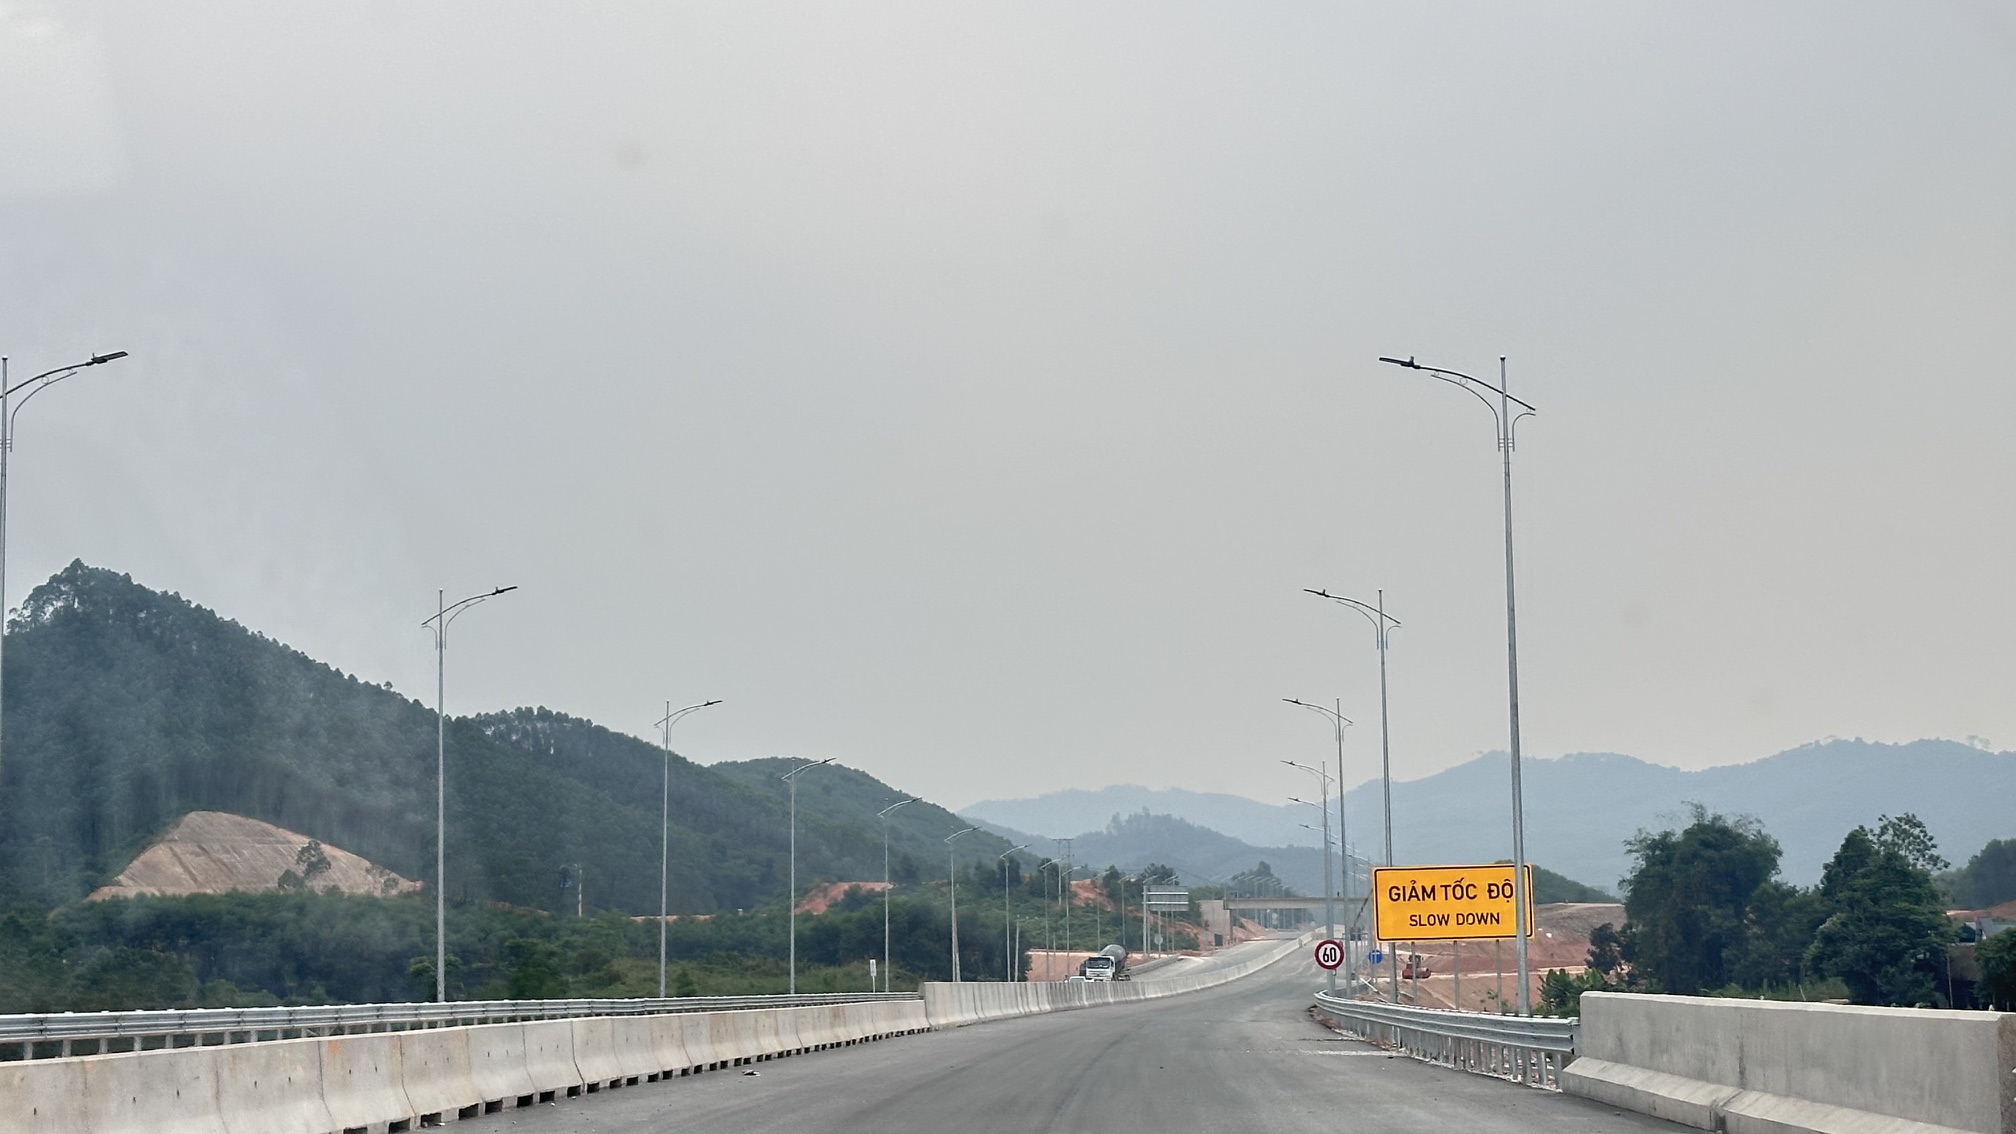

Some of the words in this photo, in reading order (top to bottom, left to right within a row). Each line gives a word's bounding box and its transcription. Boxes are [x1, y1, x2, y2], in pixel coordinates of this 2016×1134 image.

[1388, 880, 1436, 902] GIẢM
[1440, 877, 1478, 901] TỐC
[1487, 879, 1514, 903] ĐỘ
[1409, 913, 1450, 926] SLOW
[1456, 912, 1500, 925] DOWN
[1322, 947, 1337, 963] 60
